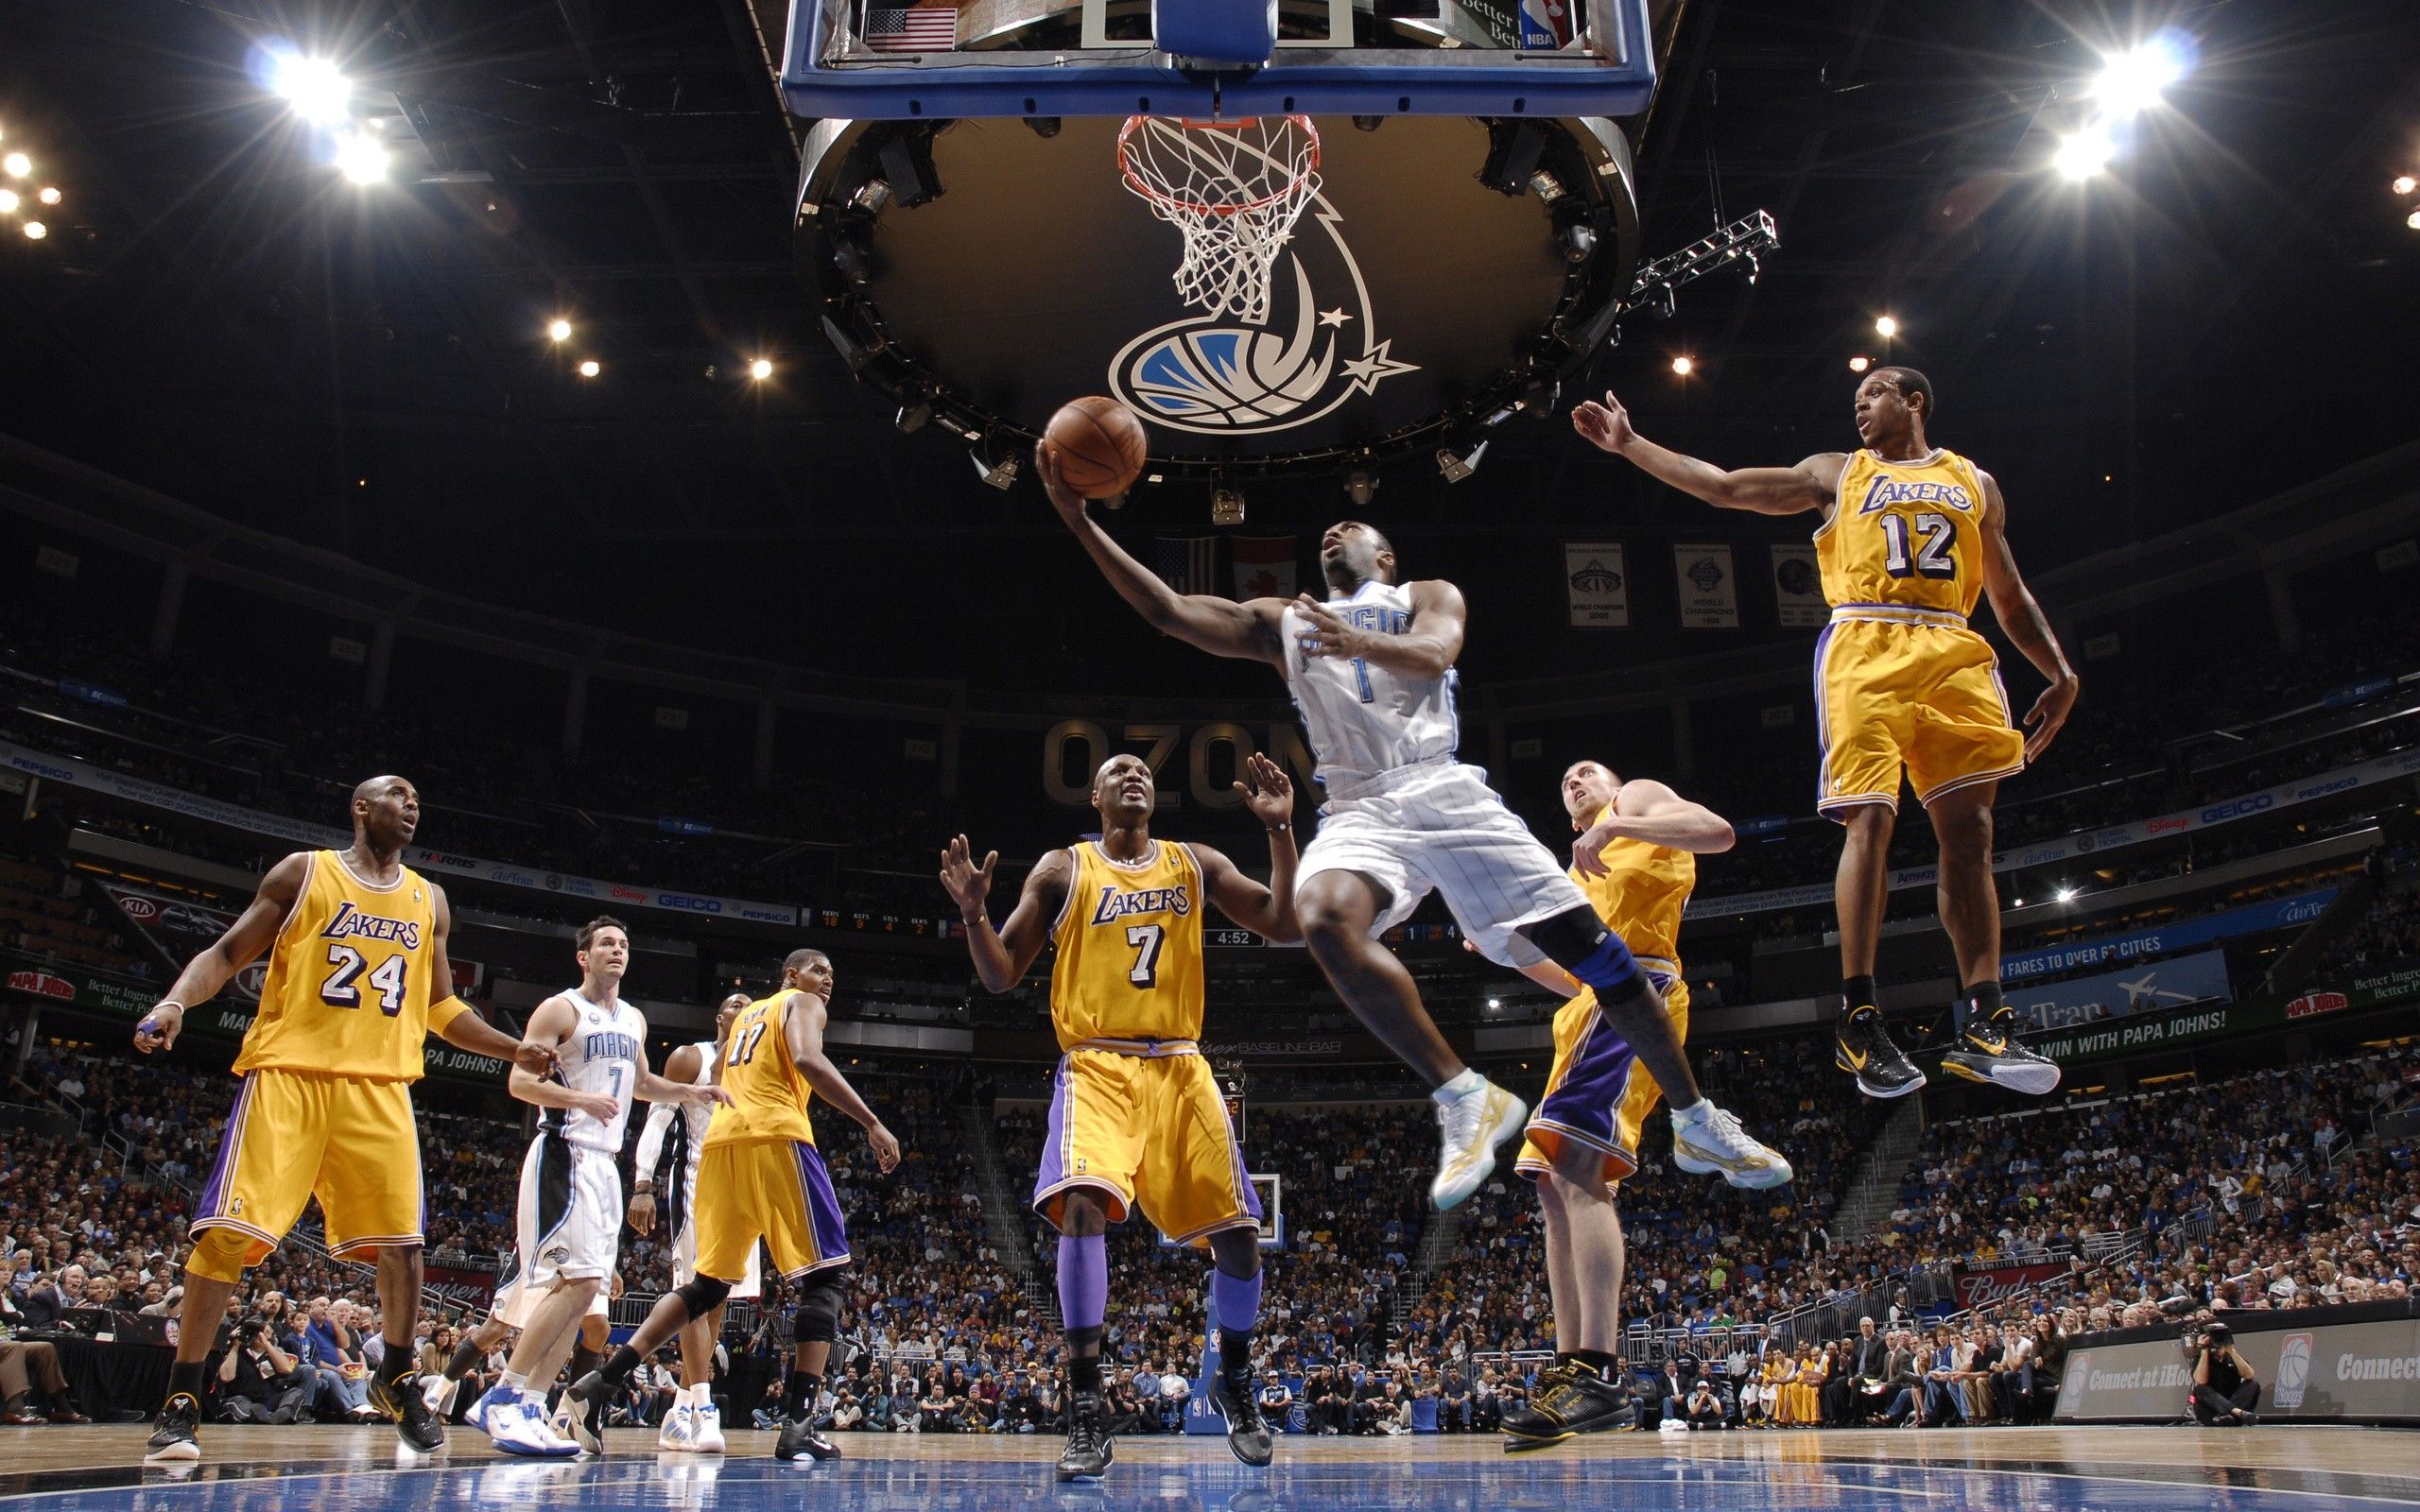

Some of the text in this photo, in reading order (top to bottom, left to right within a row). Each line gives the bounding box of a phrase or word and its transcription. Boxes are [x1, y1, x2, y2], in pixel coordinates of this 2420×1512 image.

[1527, 33, 1554, 45] NBA
[1858, 474, 1974, 516] LAKERS
[1880, 513, 1957, 580] 12
[1350, 657, 1374, 703] 1
[13, 757, 73, 781] PEPSICO
[1044, 720, 1325, 810] OZON
[2298, 777, 2358, 799] PEPSICO
[2202, 793, 2273, 824] GEICO
[2147, 818, 2189, 833] Disney
[420, 850, 478, 868] HARRIS
[1897, 868, 1937, 885] Amway
[125, 901, 149, 915] KIA
[658, 894, 722, 913] GEICO
[1091, 885, 1191, 927] LAKERS
[320, 901, 421, 952] LAKERS
[742, 909, 790, 923] PEPSICO
[1218, 932, 1250, 944] 4:52
[1409, 926, 1415, 940] 1
[1447, 925, 1455, 938] 4
[1126, 923, 1165, 989] 7
[2008, 956, 2045, 978] FARES
[2047, 955, 2063, 970] TO
[2066, 948, 2099, 967] OVER
[2119, 936, 2161, 956] CITIES
[88, 978, 161, 1003] Better Ingredi
[320, 943, 408, 1018] 24
[2354, 974, 2389, 990] Better
[2374, 983, 2409, 999] Better
[102, 995, 133, 1011] Better
[727, 1021, 767, 1067] 17
[2040, 1010, 2227, 1057] WIN WITH PAPA JOHNS!
[1238, 1041, 1307, 1054] BASELINE
[1309, 1040, 1341, 1052] BAR
[424, 1048, 504, 1074] PA JOHNS!
[608, 1066, 623, 1098] 7
[2089, 1363, 2192, 1391] Connect at iHoo
